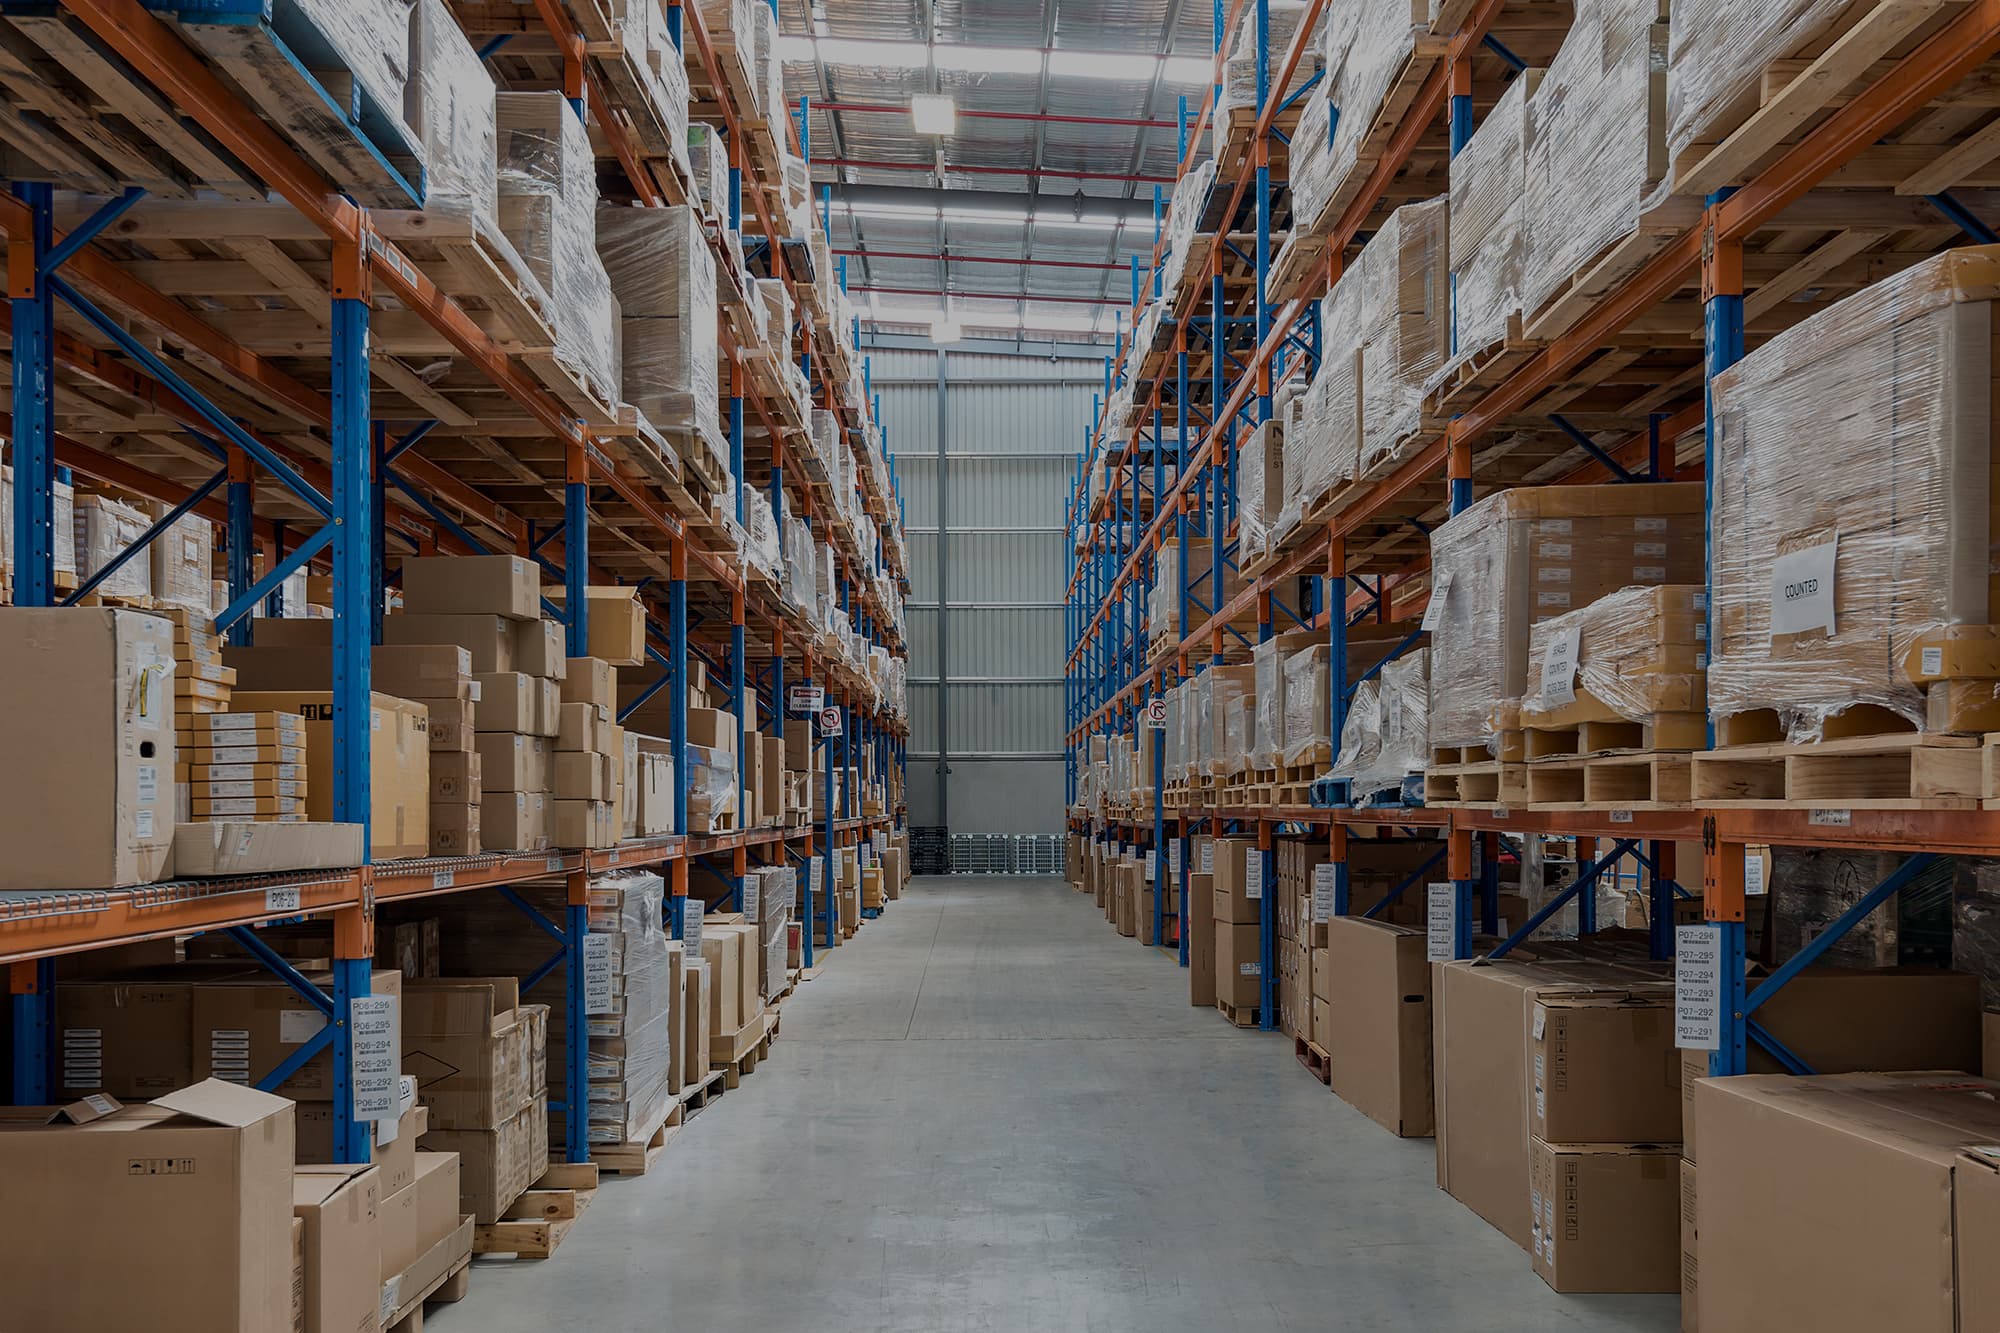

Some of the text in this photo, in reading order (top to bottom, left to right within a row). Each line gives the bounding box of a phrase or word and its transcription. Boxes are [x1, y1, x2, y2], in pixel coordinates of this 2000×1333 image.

[1785, 579, 1818, 598] COUNTED
[1678, 931, 1714, 940] P07-296
[1678, 951, 1714, 960] P07-295
[1678, 970, 1714, 979] P07-294
[1678, 988, 1714, 997] P07-293
[353, 1001, 390, 1010] P06-296
[1678, 1007, 1714, 1016] P07-292
[354, 1020, 391, 1030] P06-295
[1677, 1026, 1713, 1035] P07-291
[354, 1040, 391, 1050] P06-294
[355, 1059, 392, 1068] P06-293
[355, 1078, 393, 1087] P06-292
[356, 1097, 392, 1107] P06-291
